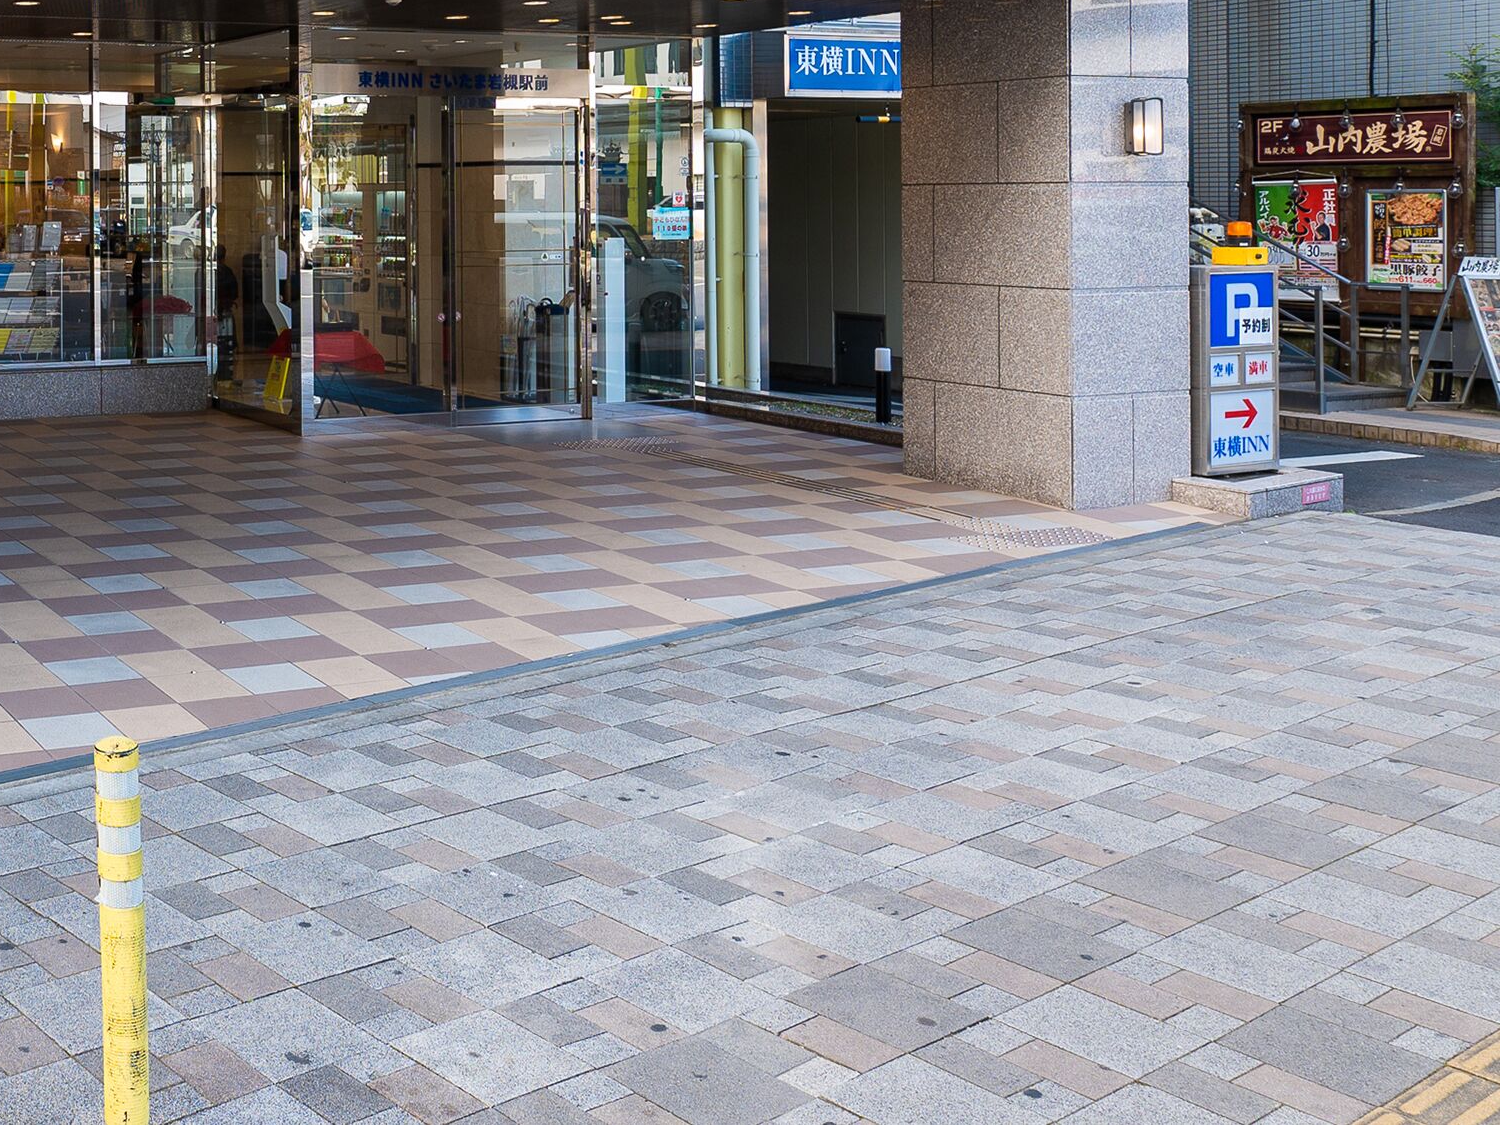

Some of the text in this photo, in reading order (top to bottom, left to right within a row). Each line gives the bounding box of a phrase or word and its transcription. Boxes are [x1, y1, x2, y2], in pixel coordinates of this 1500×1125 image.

[795, 45, 900, 76] 東横INN
[358, 70, 549, 92] 東横INN さいたま岩槻駅前
[1260, 120, 1284, 133] 2F
[1305, 120, 1428, 155] 山内農場
[1258, 190, 1270, 223] アルバイ
[1226, 282, 1259, 338] P
[1213, 362, 1235, 378] 空車
[1248, 360, 1269, 375] 満車
[1213, 434, 1270, 459] 東横INN
